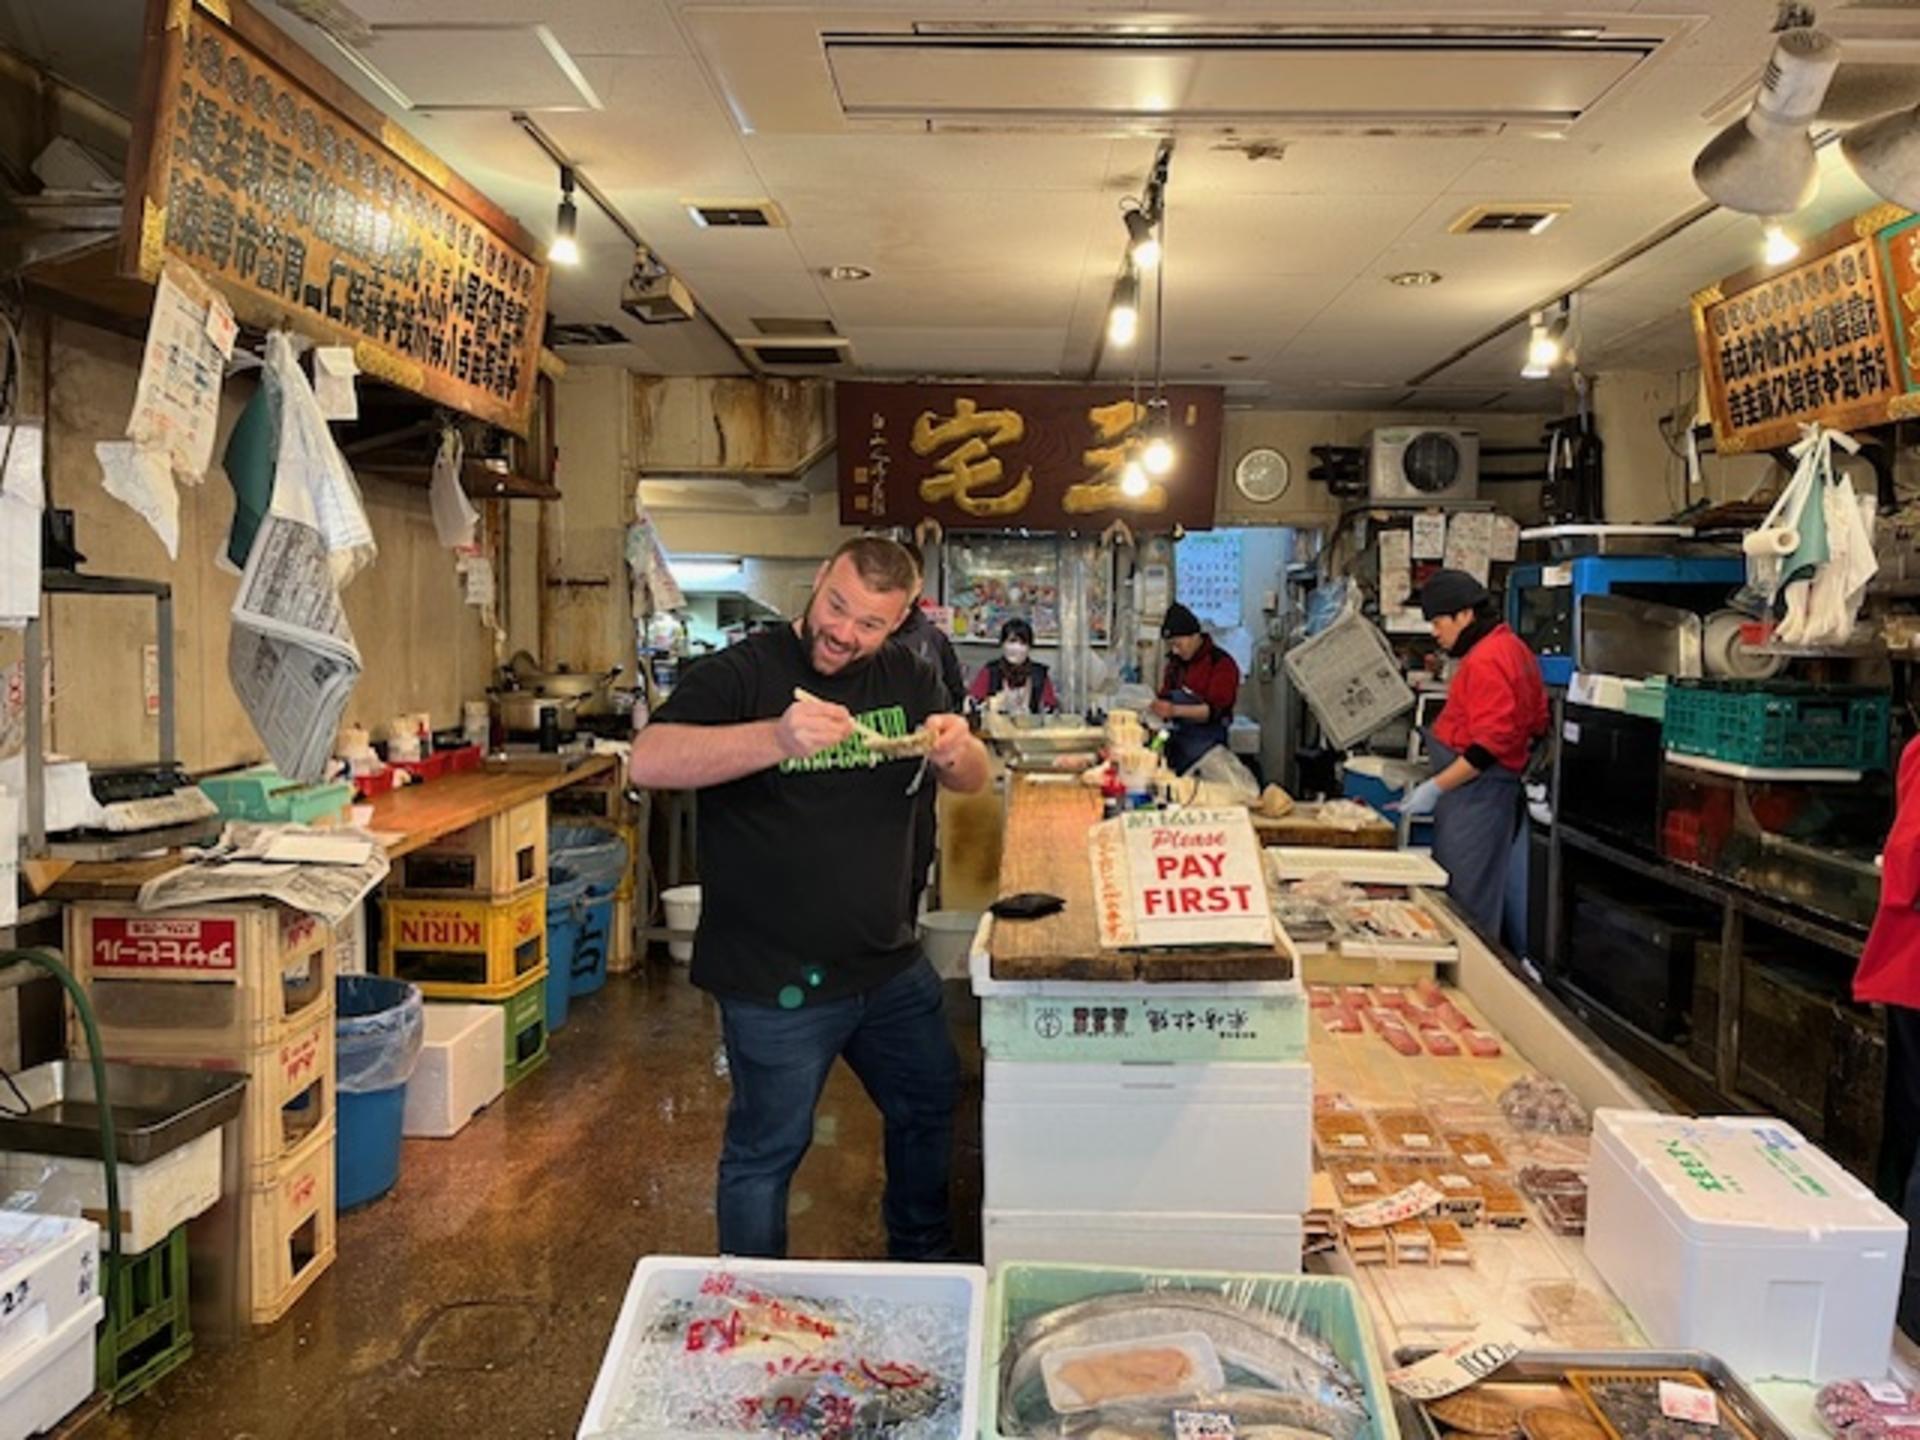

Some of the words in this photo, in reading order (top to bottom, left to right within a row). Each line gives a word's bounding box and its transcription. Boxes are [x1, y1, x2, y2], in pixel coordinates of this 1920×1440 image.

[1152, 829, 1227, 851] Please
[1156, 852, 1227, 880] PAY
[1143, 884, 1252, 916] FIRST
[400, 926, 481, 950] KIRIN
[96, 939, 232, 967] アサヒビール
